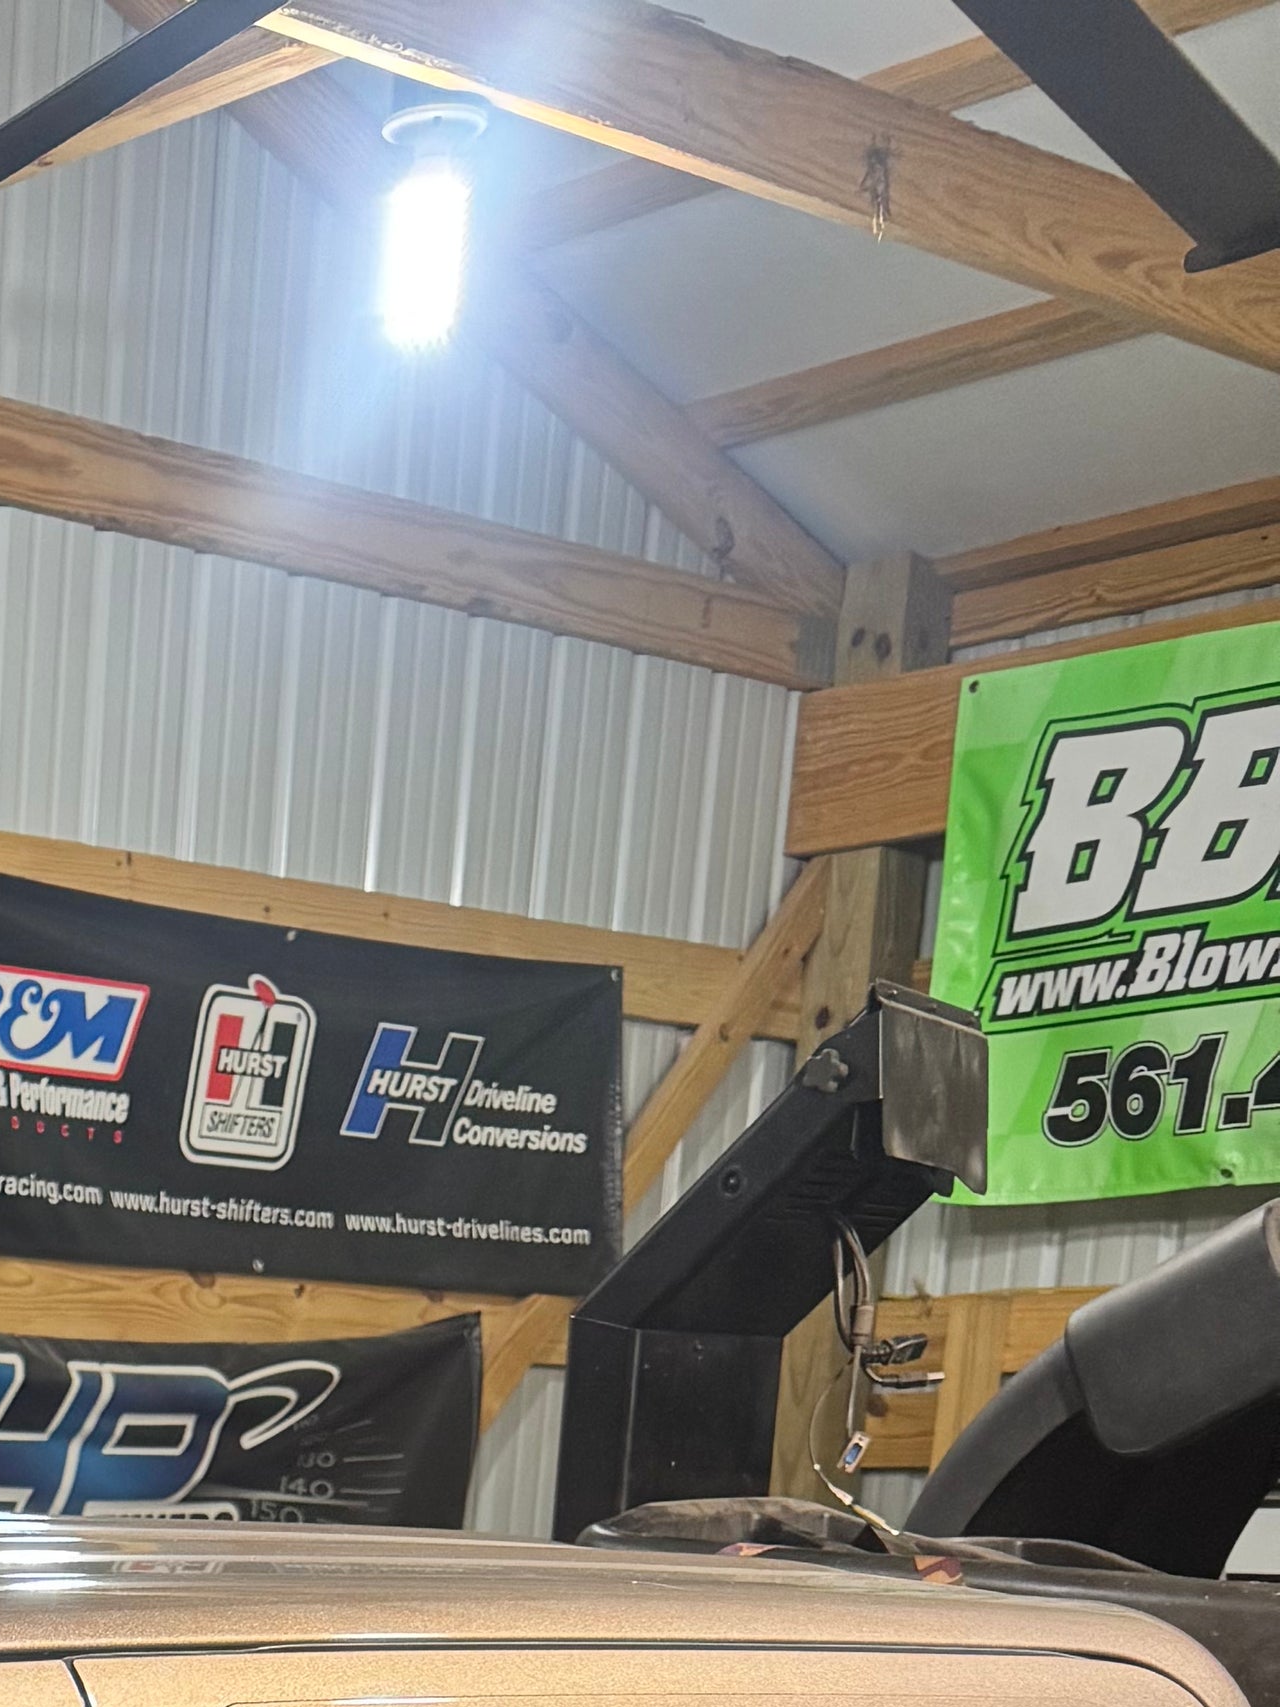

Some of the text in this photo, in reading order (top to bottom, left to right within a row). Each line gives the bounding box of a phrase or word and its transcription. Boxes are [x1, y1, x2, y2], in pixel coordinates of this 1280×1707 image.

[1007, 696, 1280, 941] BB
[218, 1048, 288, 1078] HURST
[9, 1073, 131, 1123] Performance
[366, 1069, 458, 1103] HURST
[464, 1079, 558, 1114] Driveline
[206, 1111, 276, 1138] SHIFTERS
[452, 1117, 588, 1154] Conversions
[110, 1190, 335, 1230] www.hurst-shifters.com
[345, 1213, 591, 1246] www.hurst-drivelines.com
[280, 1475, 334, 1499] 140
[250, 1500, 304, 1524] 150
